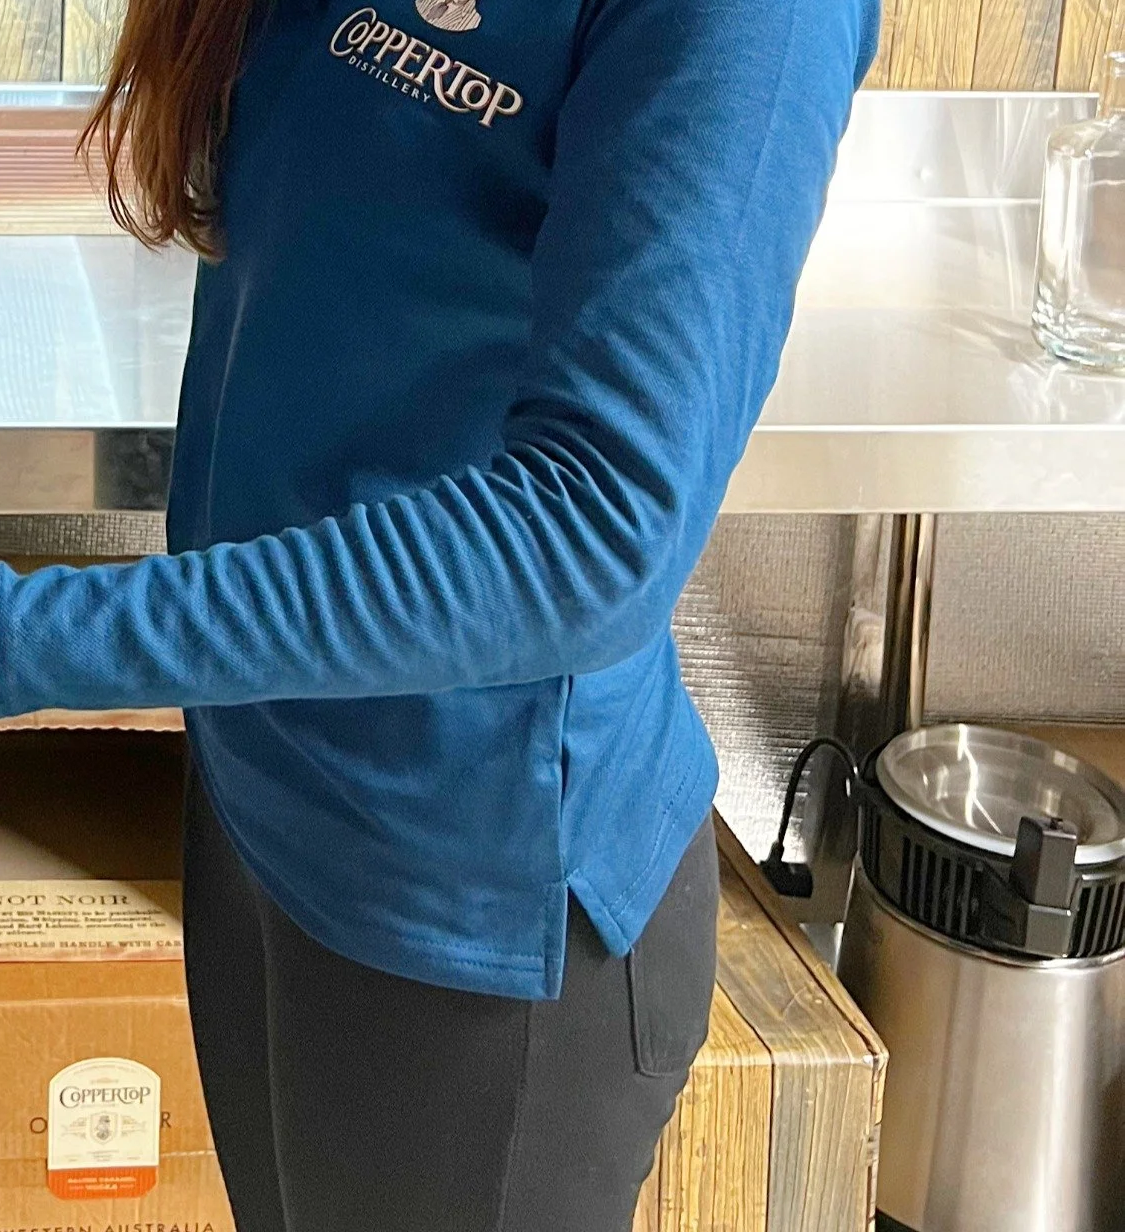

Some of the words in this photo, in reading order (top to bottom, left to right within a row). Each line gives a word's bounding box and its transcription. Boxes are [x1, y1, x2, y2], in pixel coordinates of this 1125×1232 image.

[329, 7, 524, 128] COPPERTOP
[348, 55, 431, 104] DISTILLERY
[56, 894, 132, 906] NOIR
[156, 939, 183, 948] CAR
